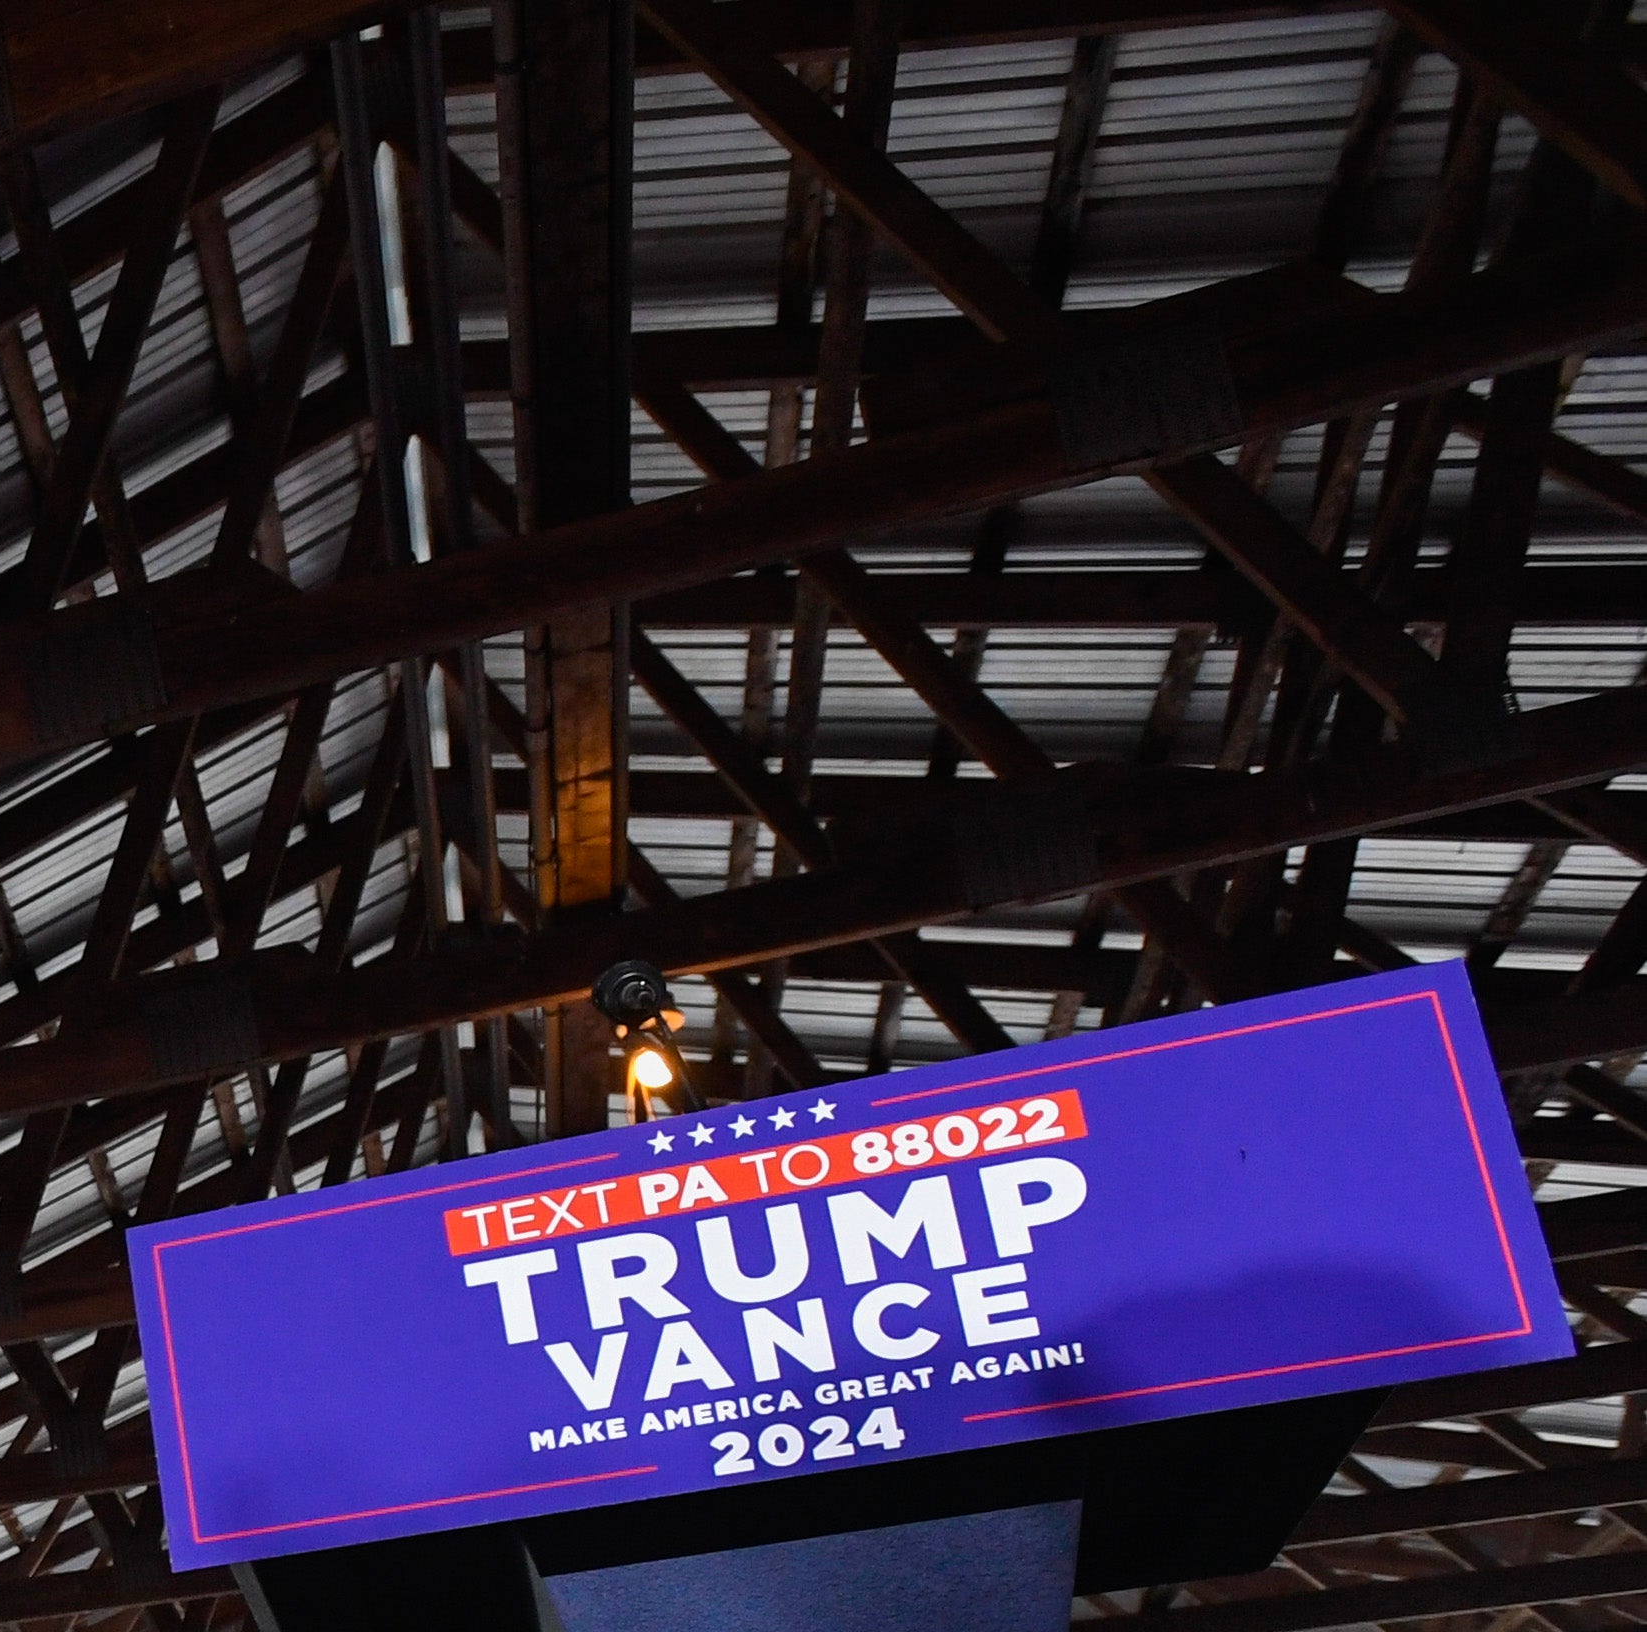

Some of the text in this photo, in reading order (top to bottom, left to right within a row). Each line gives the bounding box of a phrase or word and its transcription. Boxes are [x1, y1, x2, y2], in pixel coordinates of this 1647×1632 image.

[462, 1098, 1066, 1247] TEXT PA TO 88022
[463, 1157, 1087, 1345] TRUMP
[529, 1342, 1085, 1452] MAKE AMERICA GREAT AGAIN!
[544, 1262, 1040, 1411] VANCE
[709, 1406, 905, 1476] 2024
